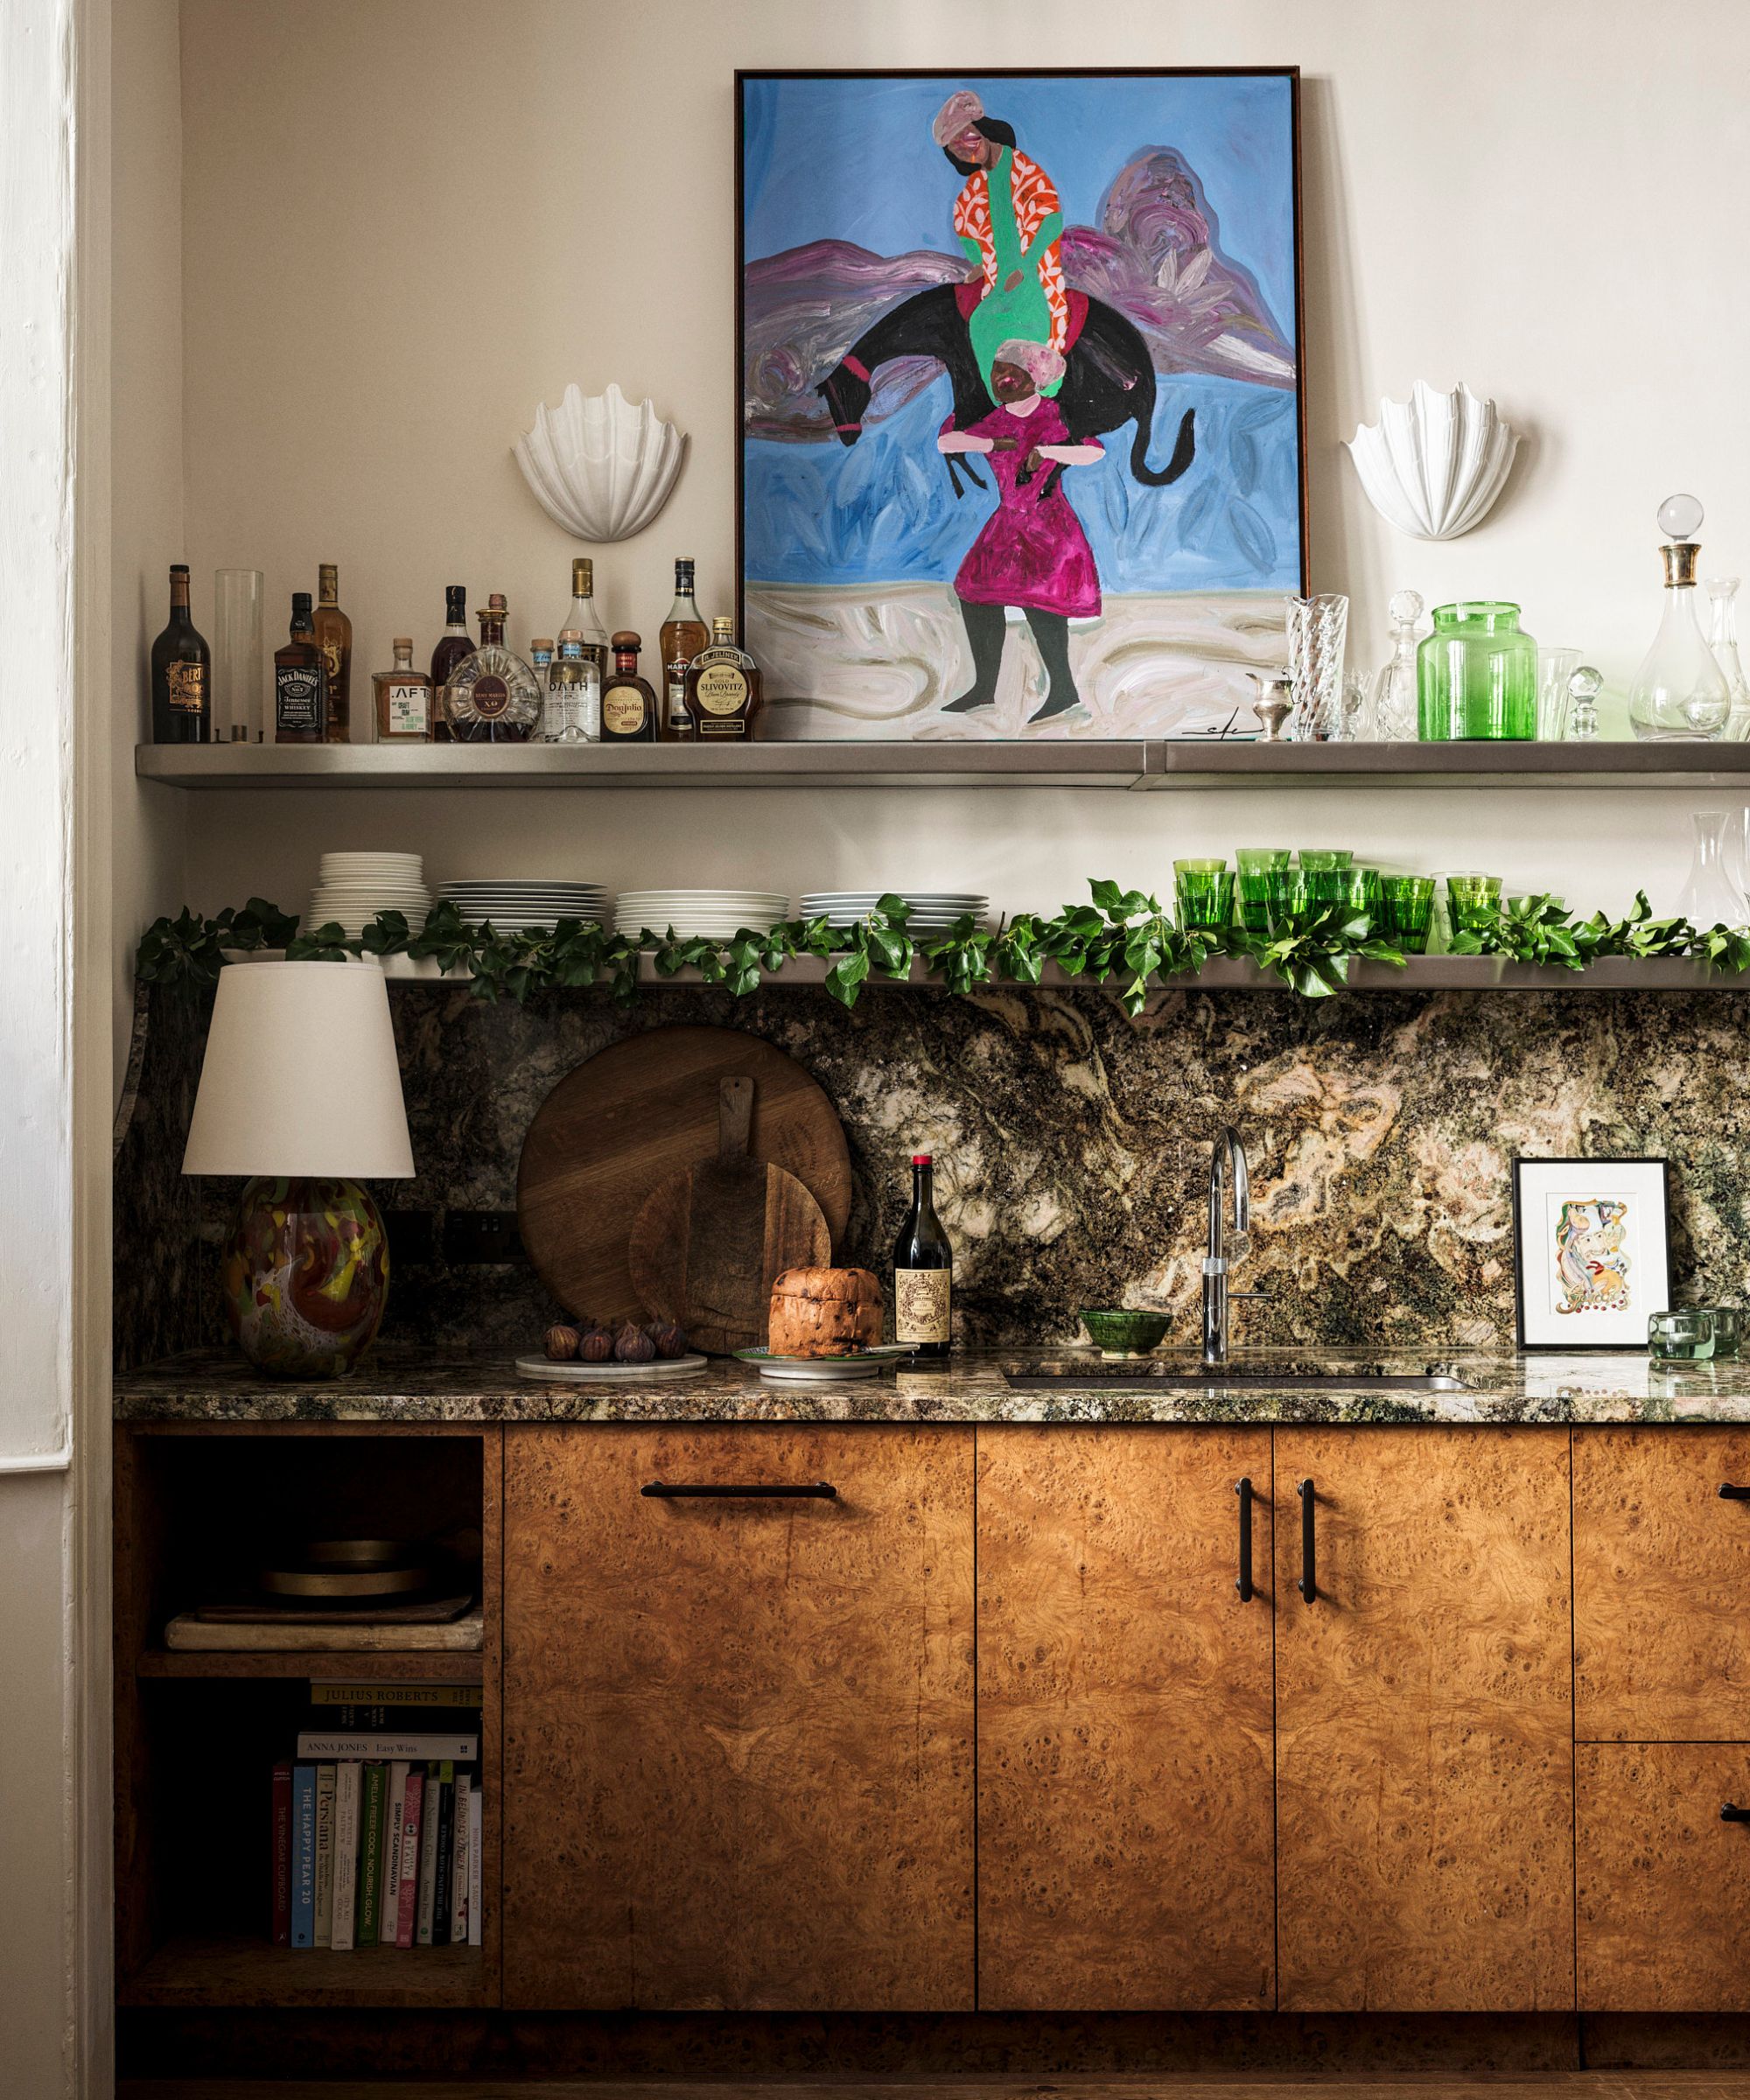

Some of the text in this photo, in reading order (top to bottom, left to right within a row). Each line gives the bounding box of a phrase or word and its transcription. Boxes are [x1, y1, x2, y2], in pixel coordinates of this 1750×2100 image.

[278, 670, 318, 687] JACK DANIEL'S
[324, 1690, 438, 1702] JULIUS ROBERTS
[338, 1743, 368, 1753] JONES
[376, 1744, 396, 1754] Easy
[396, 1744, 417, 1753] Wins
[458, 1785, 467, 1794] IN
[318, 1790, 332, 1850] Persiana
[277, 1806, 287, 1912] THE VINEGAR CUPBOARD
[301, 1787, 312, 1904] THE HAPPY PEAR 20
[457, 1838, 466, 1870] KITCHEN
[390, 1833, 400, 1895] SCANDINAVIAN
